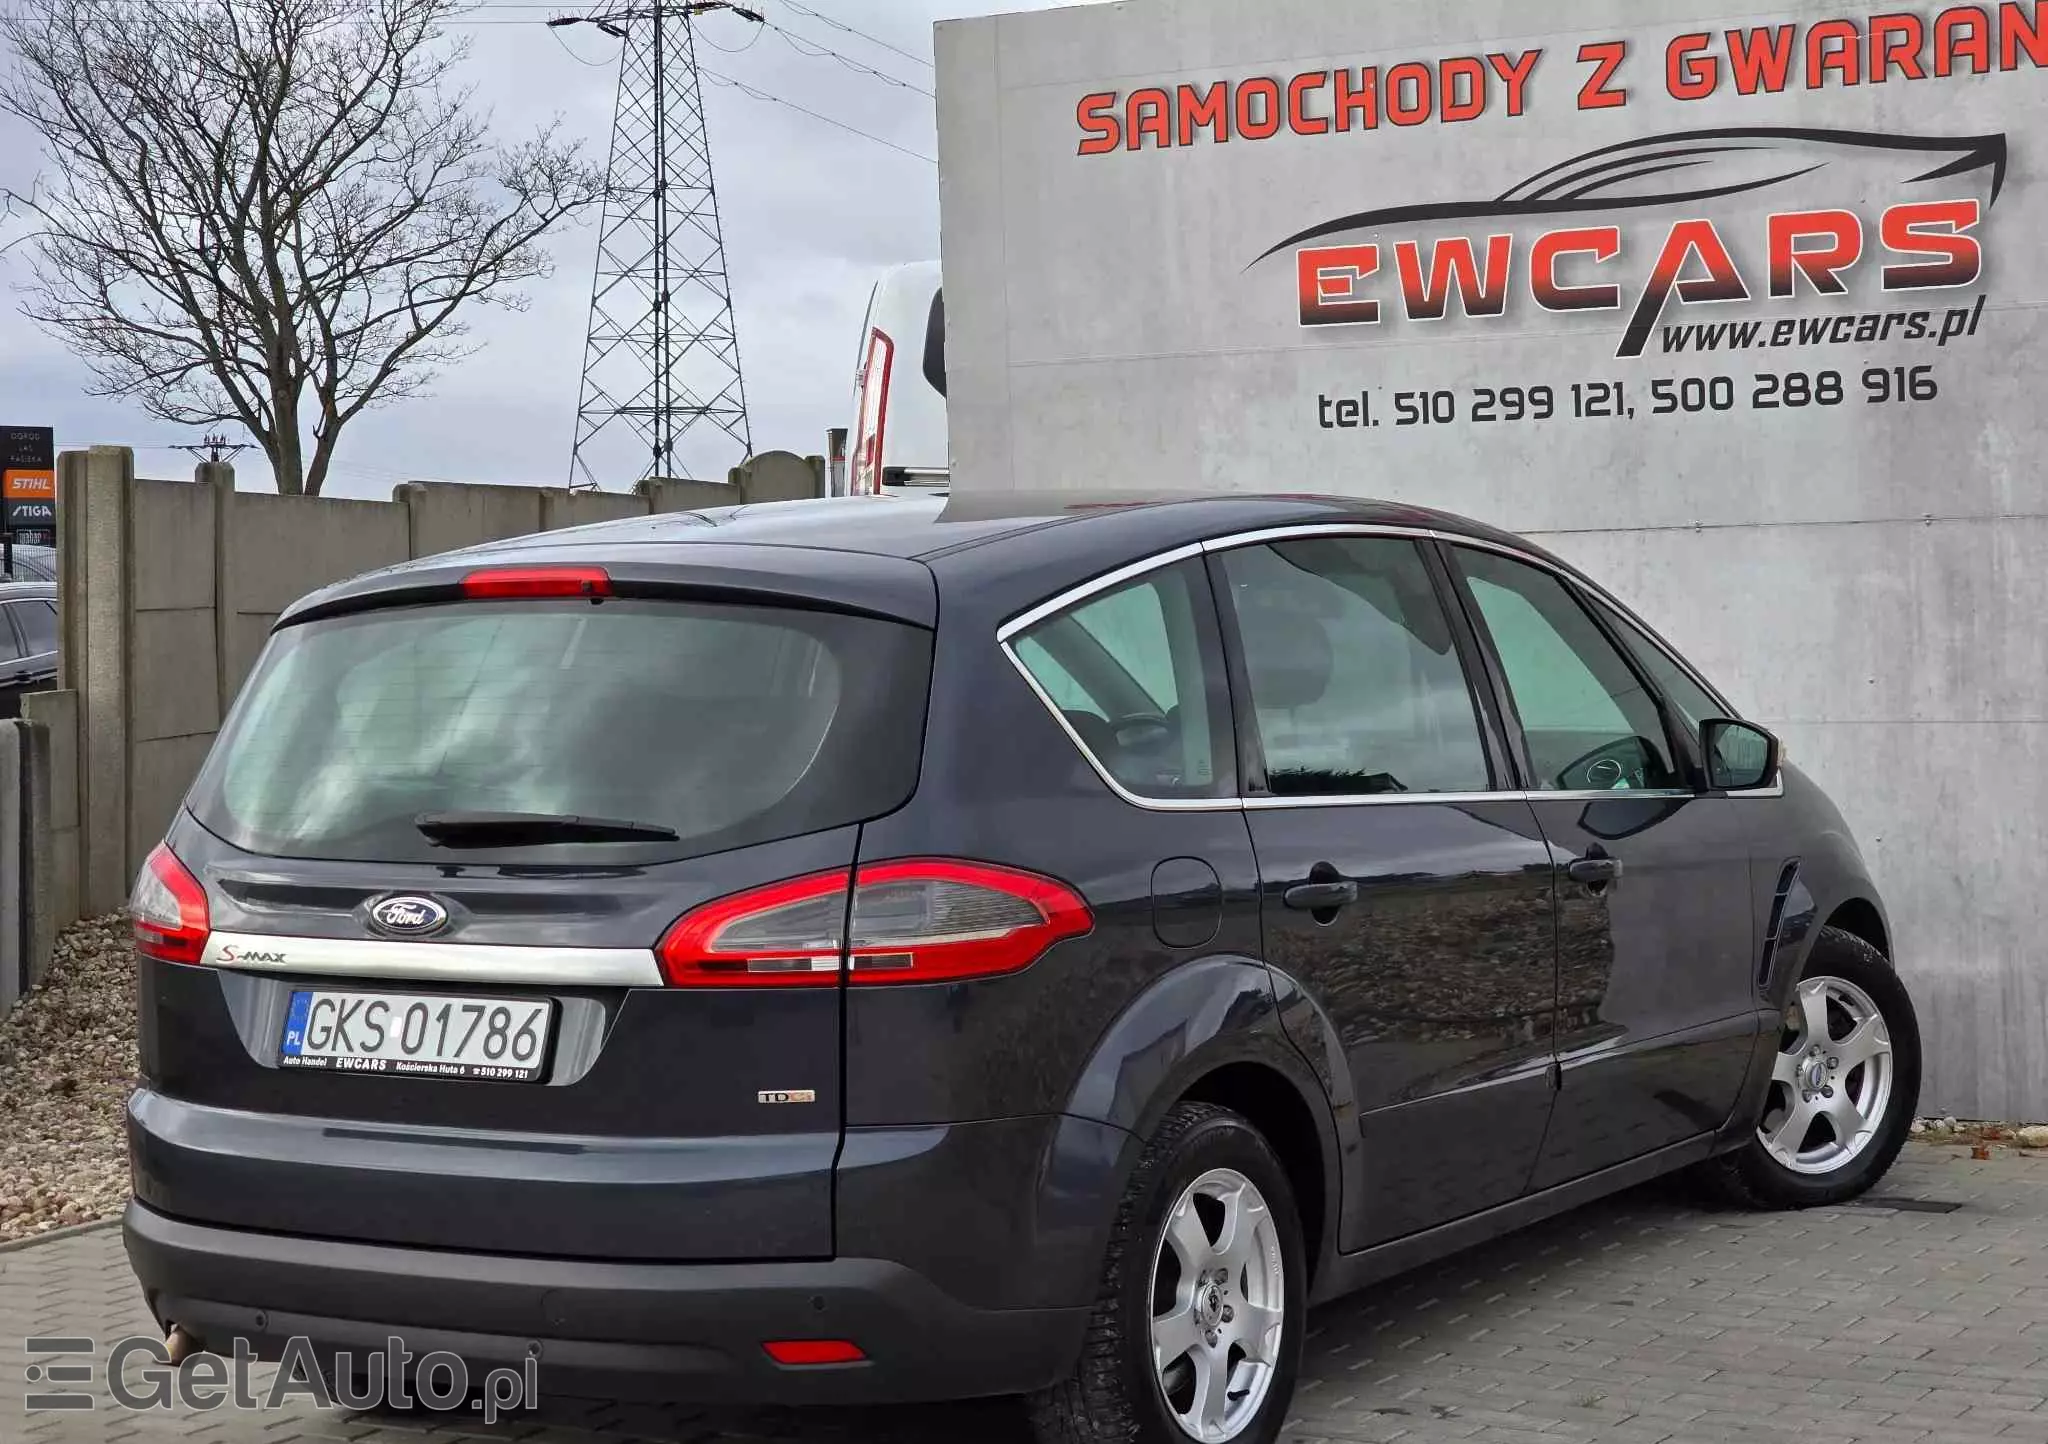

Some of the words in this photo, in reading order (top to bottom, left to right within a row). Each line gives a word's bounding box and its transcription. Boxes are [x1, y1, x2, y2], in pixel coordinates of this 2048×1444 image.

[1077, 49, 1543, 155] SAMOCHODY
[1577, 41, 1627, 110] Z
[1665, 0, 2048, 100] GWARAN
[1297, 199, 1982, 358] EWCARS
[1661, 294, 1986, 354] www.ewcars.pl
[1317, 390, 1379, 428] tel.
[1394, 389, 1455, 425] 510
[1471, 386, 1553, 421] 299
[1569, 382, 1635, 423] 121,
[1651, 376, 1734, 415] 500
[1754, 370, 1843, 408] 288
[1861, 365, 1938, 403] 916
[12, 477, 51, 490] STIHL
[384, 904, 426, 925] Ford
[286, 1031, 301, 1046] PL
[307, 998, 390, 1053] GKS
[400, 1002, 543, 1061] 01786
[302, 1057, 328, 1066] Handel
[336, 1058, 387, 1071] EWCARS
[439, 1064, 459, 1075] Huta
[480, 1066, 496, 1077] 510
[497, 1067, 513, 1079] 299
[515, 1068, 529, 1080] 121
